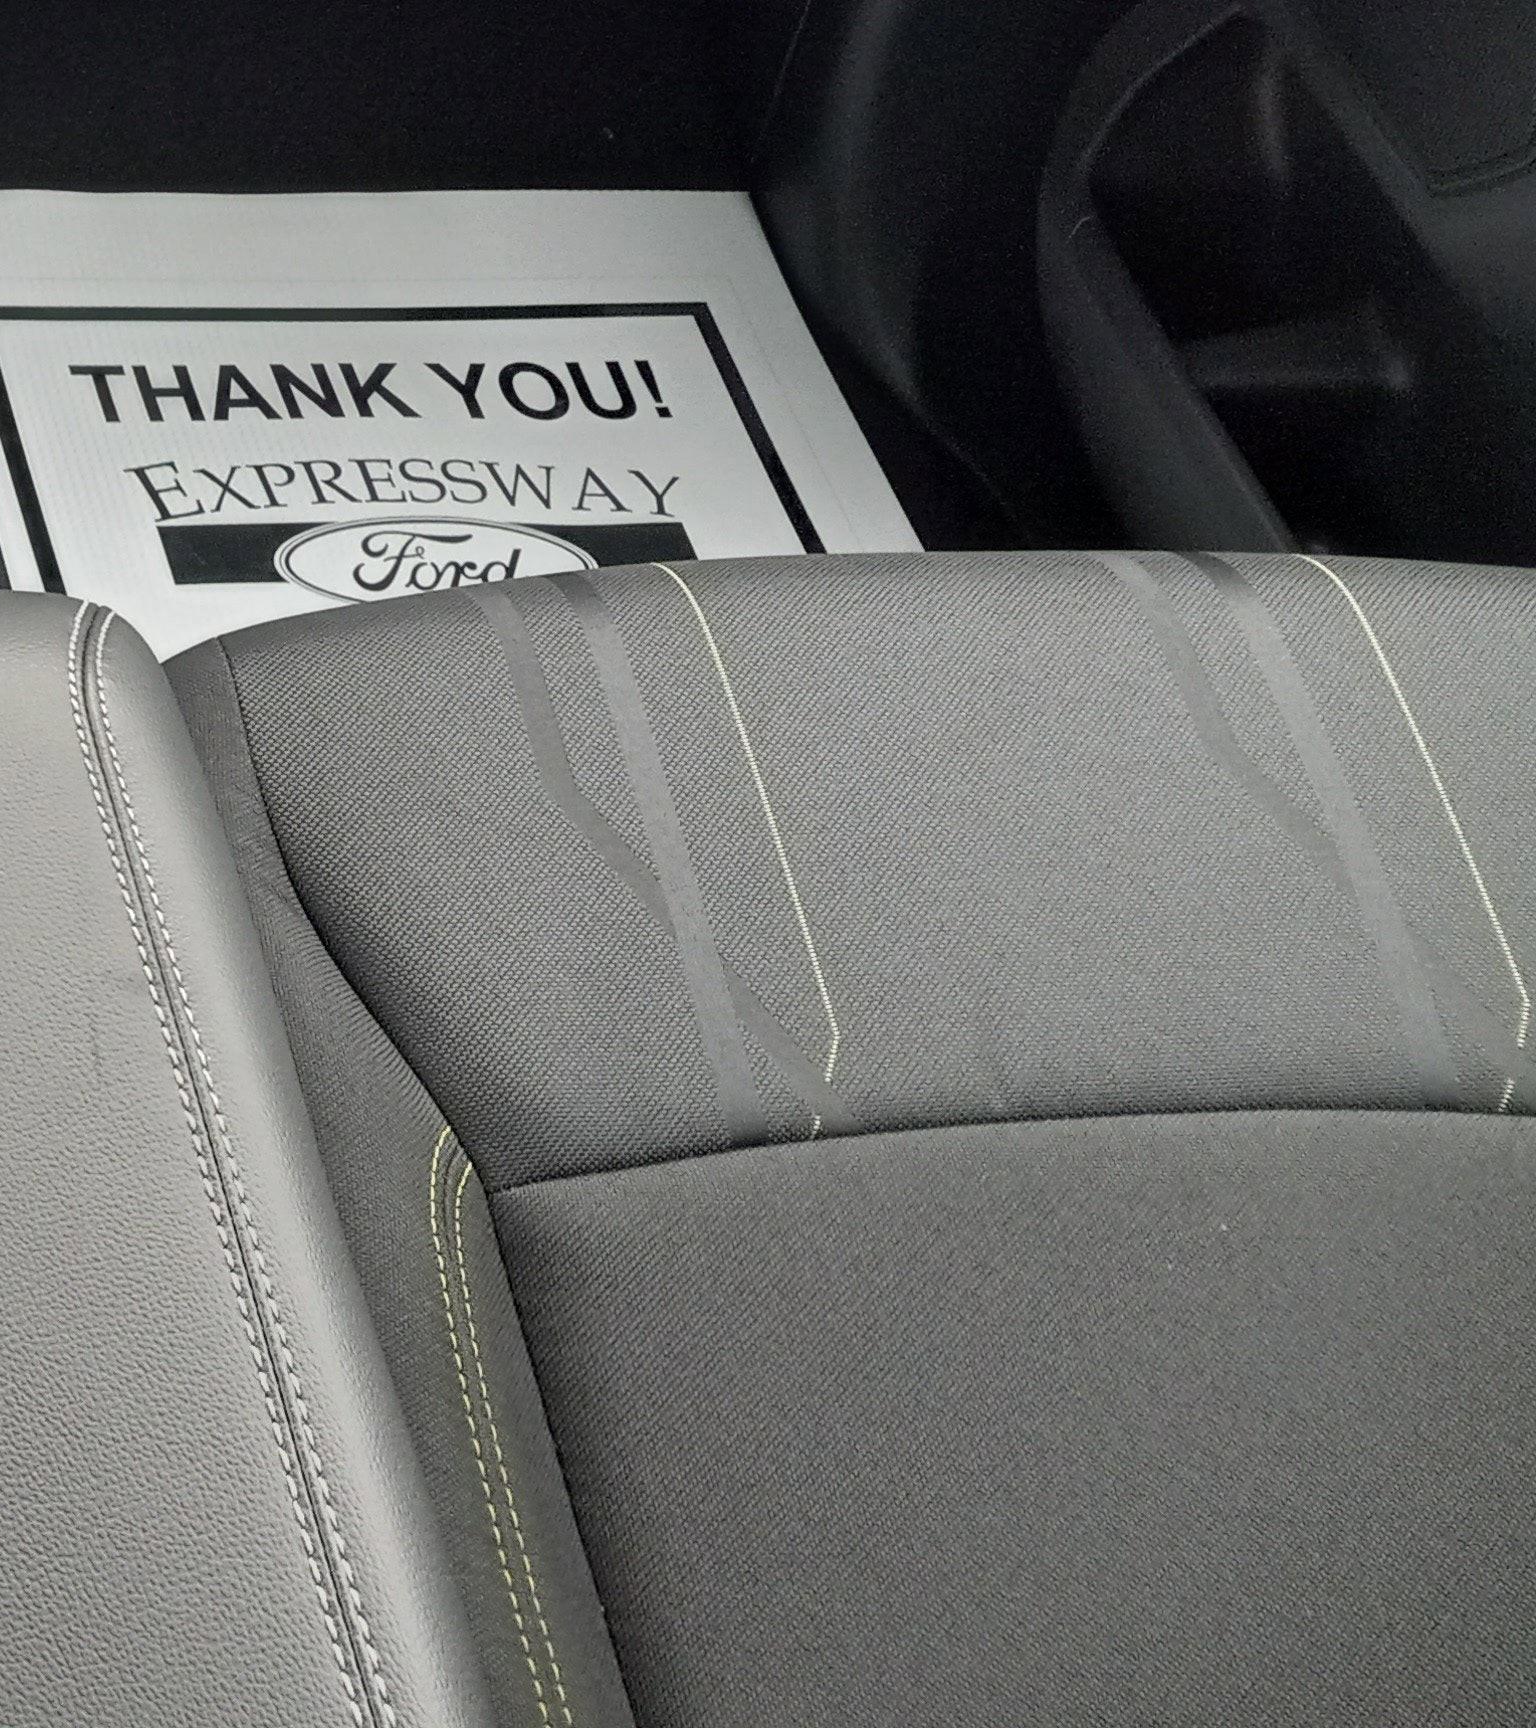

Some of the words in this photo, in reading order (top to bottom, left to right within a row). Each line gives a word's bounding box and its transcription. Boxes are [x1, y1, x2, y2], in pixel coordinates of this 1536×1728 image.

[68, 363, 422, 422] THANK
[424, 360, 673, 420] YOU!
[123, 458, 680, 522] EXPRESSWAY
[352, 530, 521, 591] Ford
